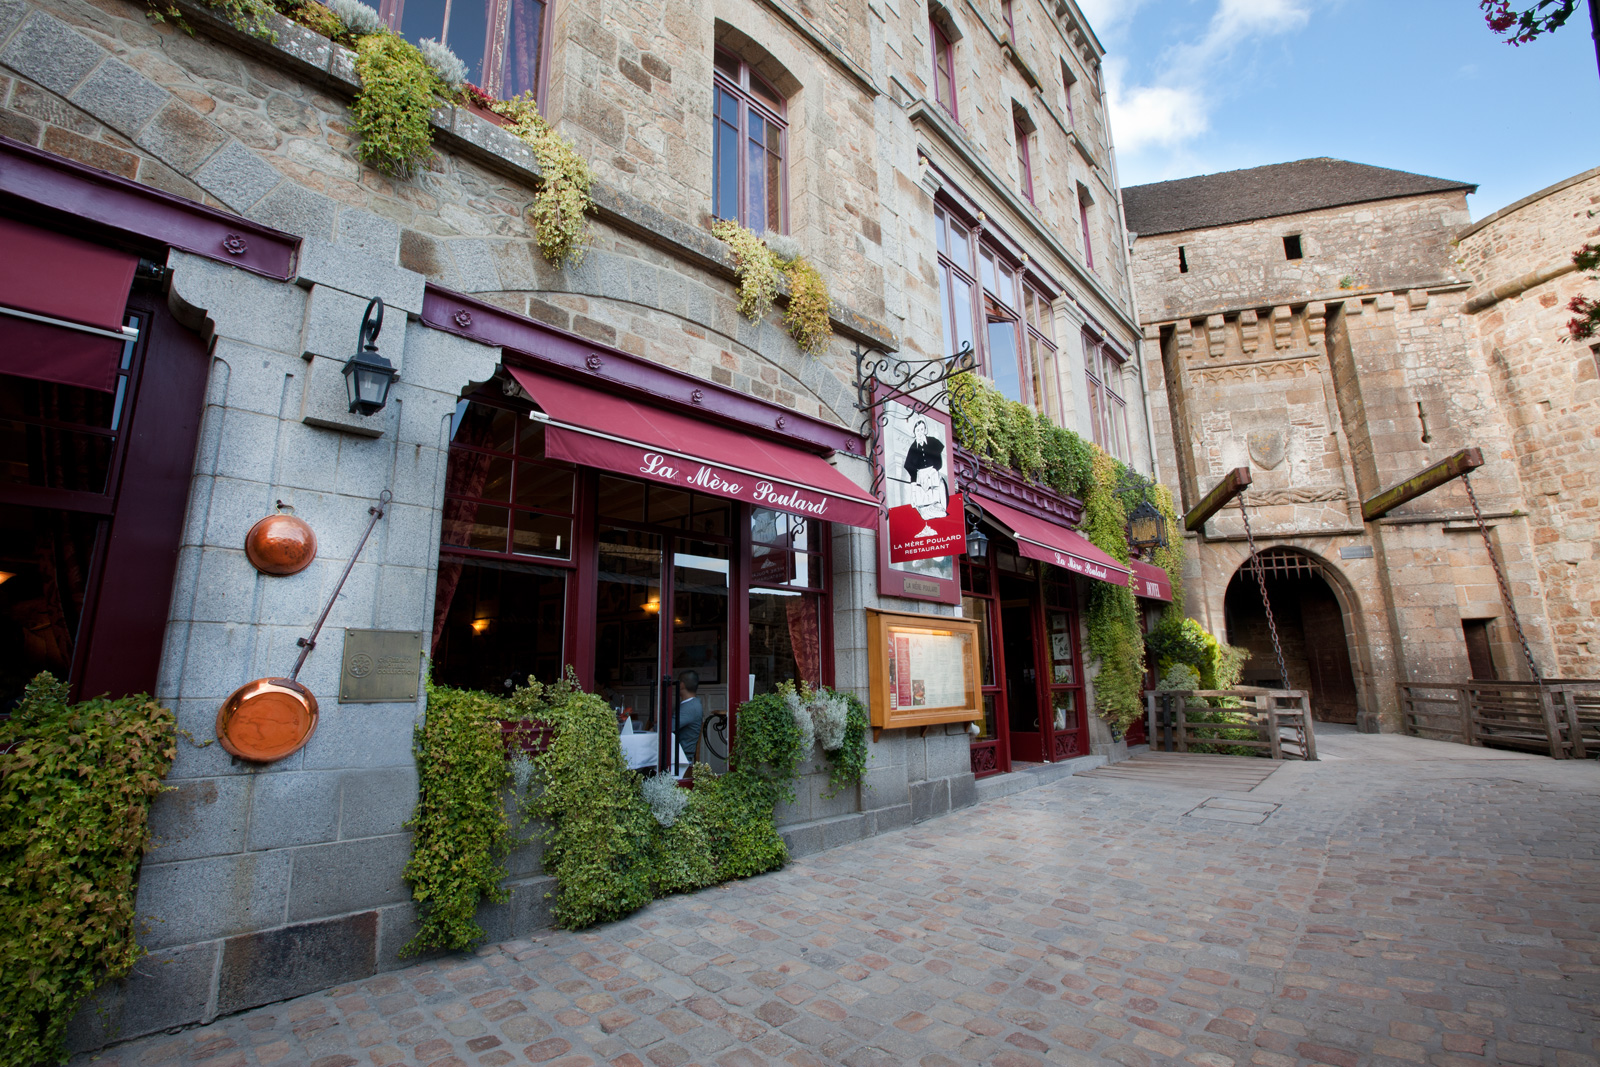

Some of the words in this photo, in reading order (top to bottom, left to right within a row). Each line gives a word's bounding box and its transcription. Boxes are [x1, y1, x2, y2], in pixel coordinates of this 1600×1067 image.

[639, 453, 679, 479] La
[686, 465, 744, 494] Mère
[752, 480, 828, 515] Poulard
[904, 539, 925, 548] MÈRE
[926, 534, 962, 545] POULARD
[904, 543, 950, 555] RESTAURANT
[1054, 552, 1066, 566] La
[1067, 556, 1083, 572] Mère
[1084, 561, 1108, 579] Poulard
[1145, 581, 1161, 596] HOTEL
